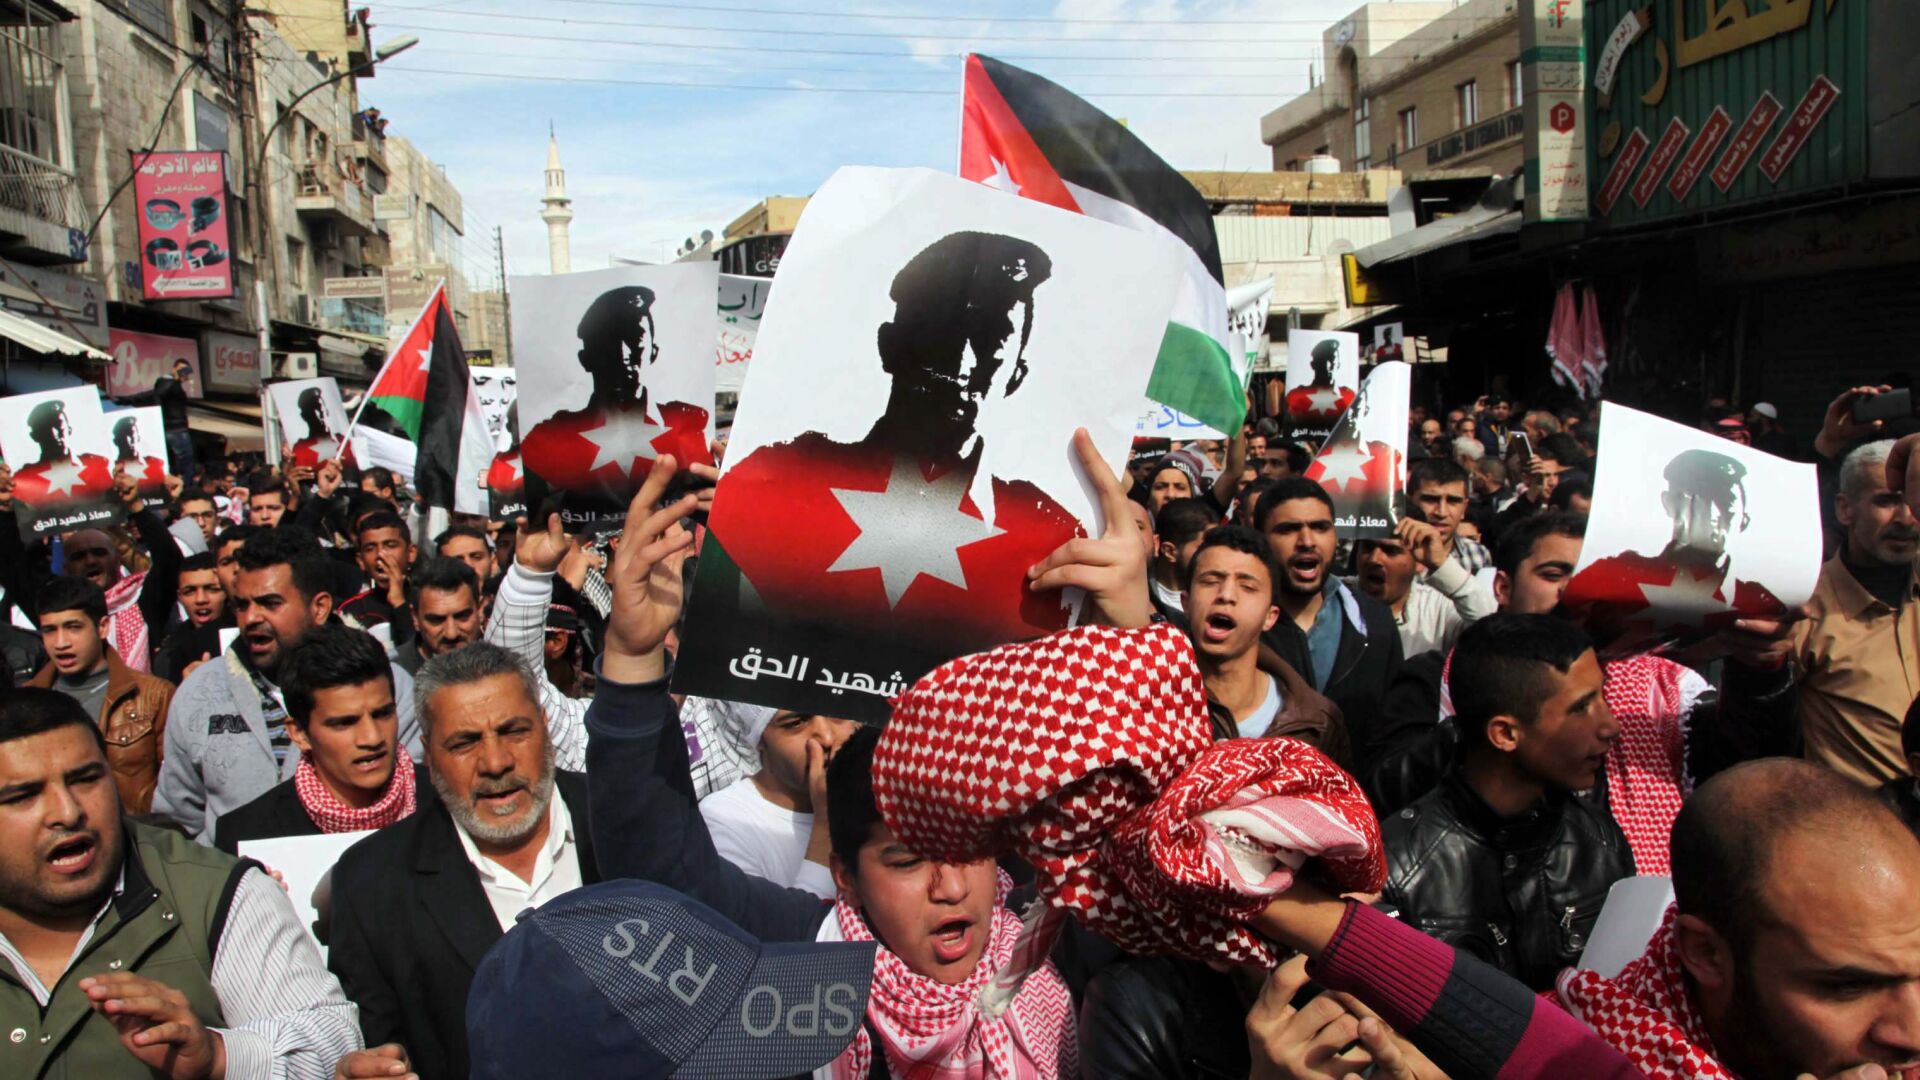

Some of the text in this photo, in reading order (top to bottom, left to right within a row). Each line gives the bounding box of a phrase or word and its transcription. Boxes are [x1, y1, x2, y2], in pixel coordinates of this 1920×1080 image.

[1558, 109, 1569, 127] P
[191, 155, 218, 177] عالم
[34, 510, 112, 532] معاذ شهيد الحق
[561, 509, 596, 523] الحق
[1334, 515, 1388, 528] معاذ شه
[729, 647, 908, 699] شهيد الحق
